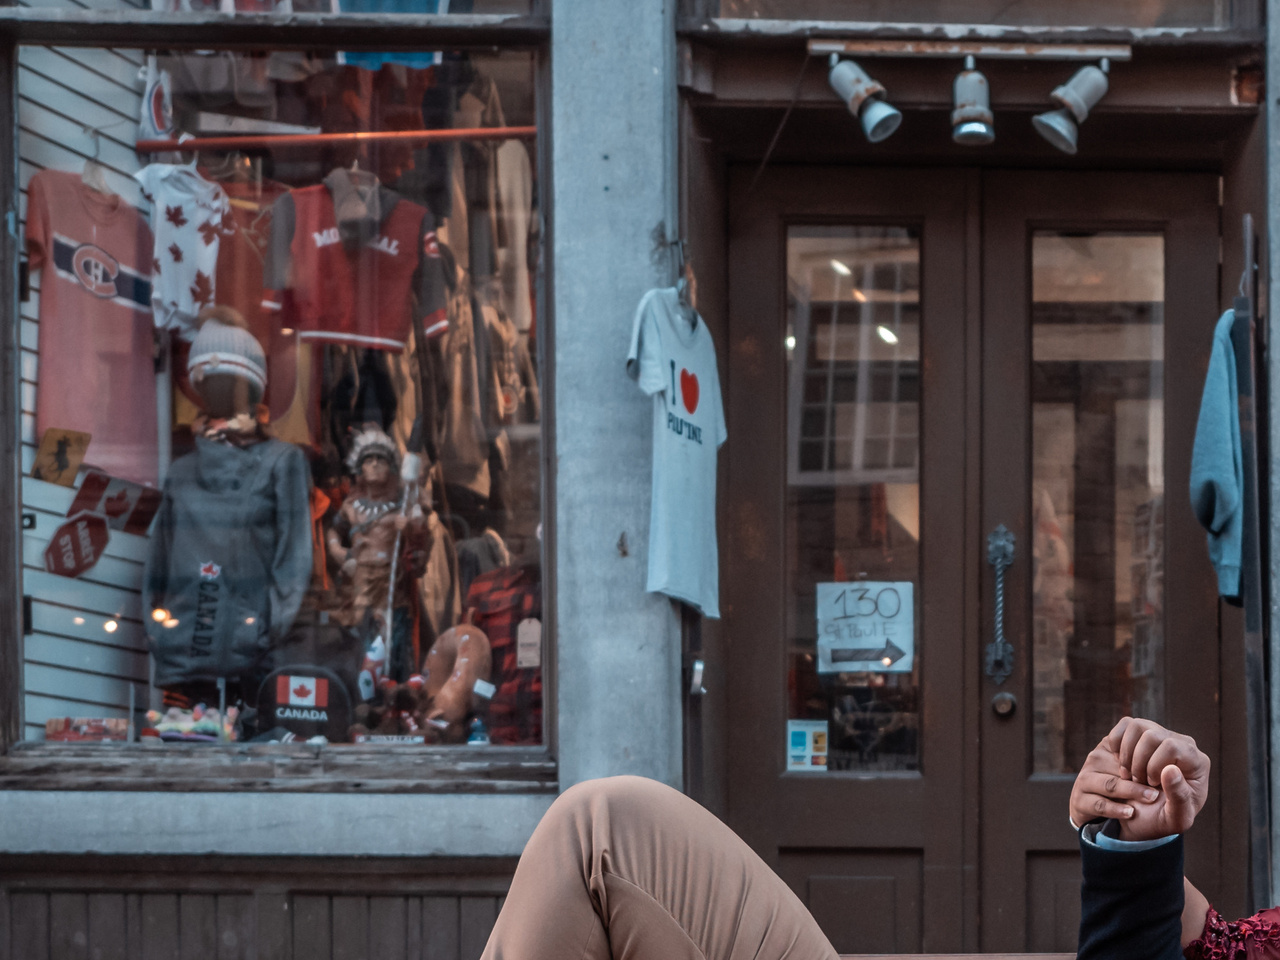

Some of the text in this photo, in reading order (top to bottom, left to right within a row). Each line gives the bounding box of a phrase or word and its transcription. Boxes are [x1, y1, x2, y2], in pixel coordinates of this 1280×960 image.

[667, 411, 703, 445] POUTINE
[59, 534, 76, 569] STOP
[191, 581, 220, 658] CANADA
[833, 587, 901, 621] 130
[276, 707, 328, 720] CANADA
